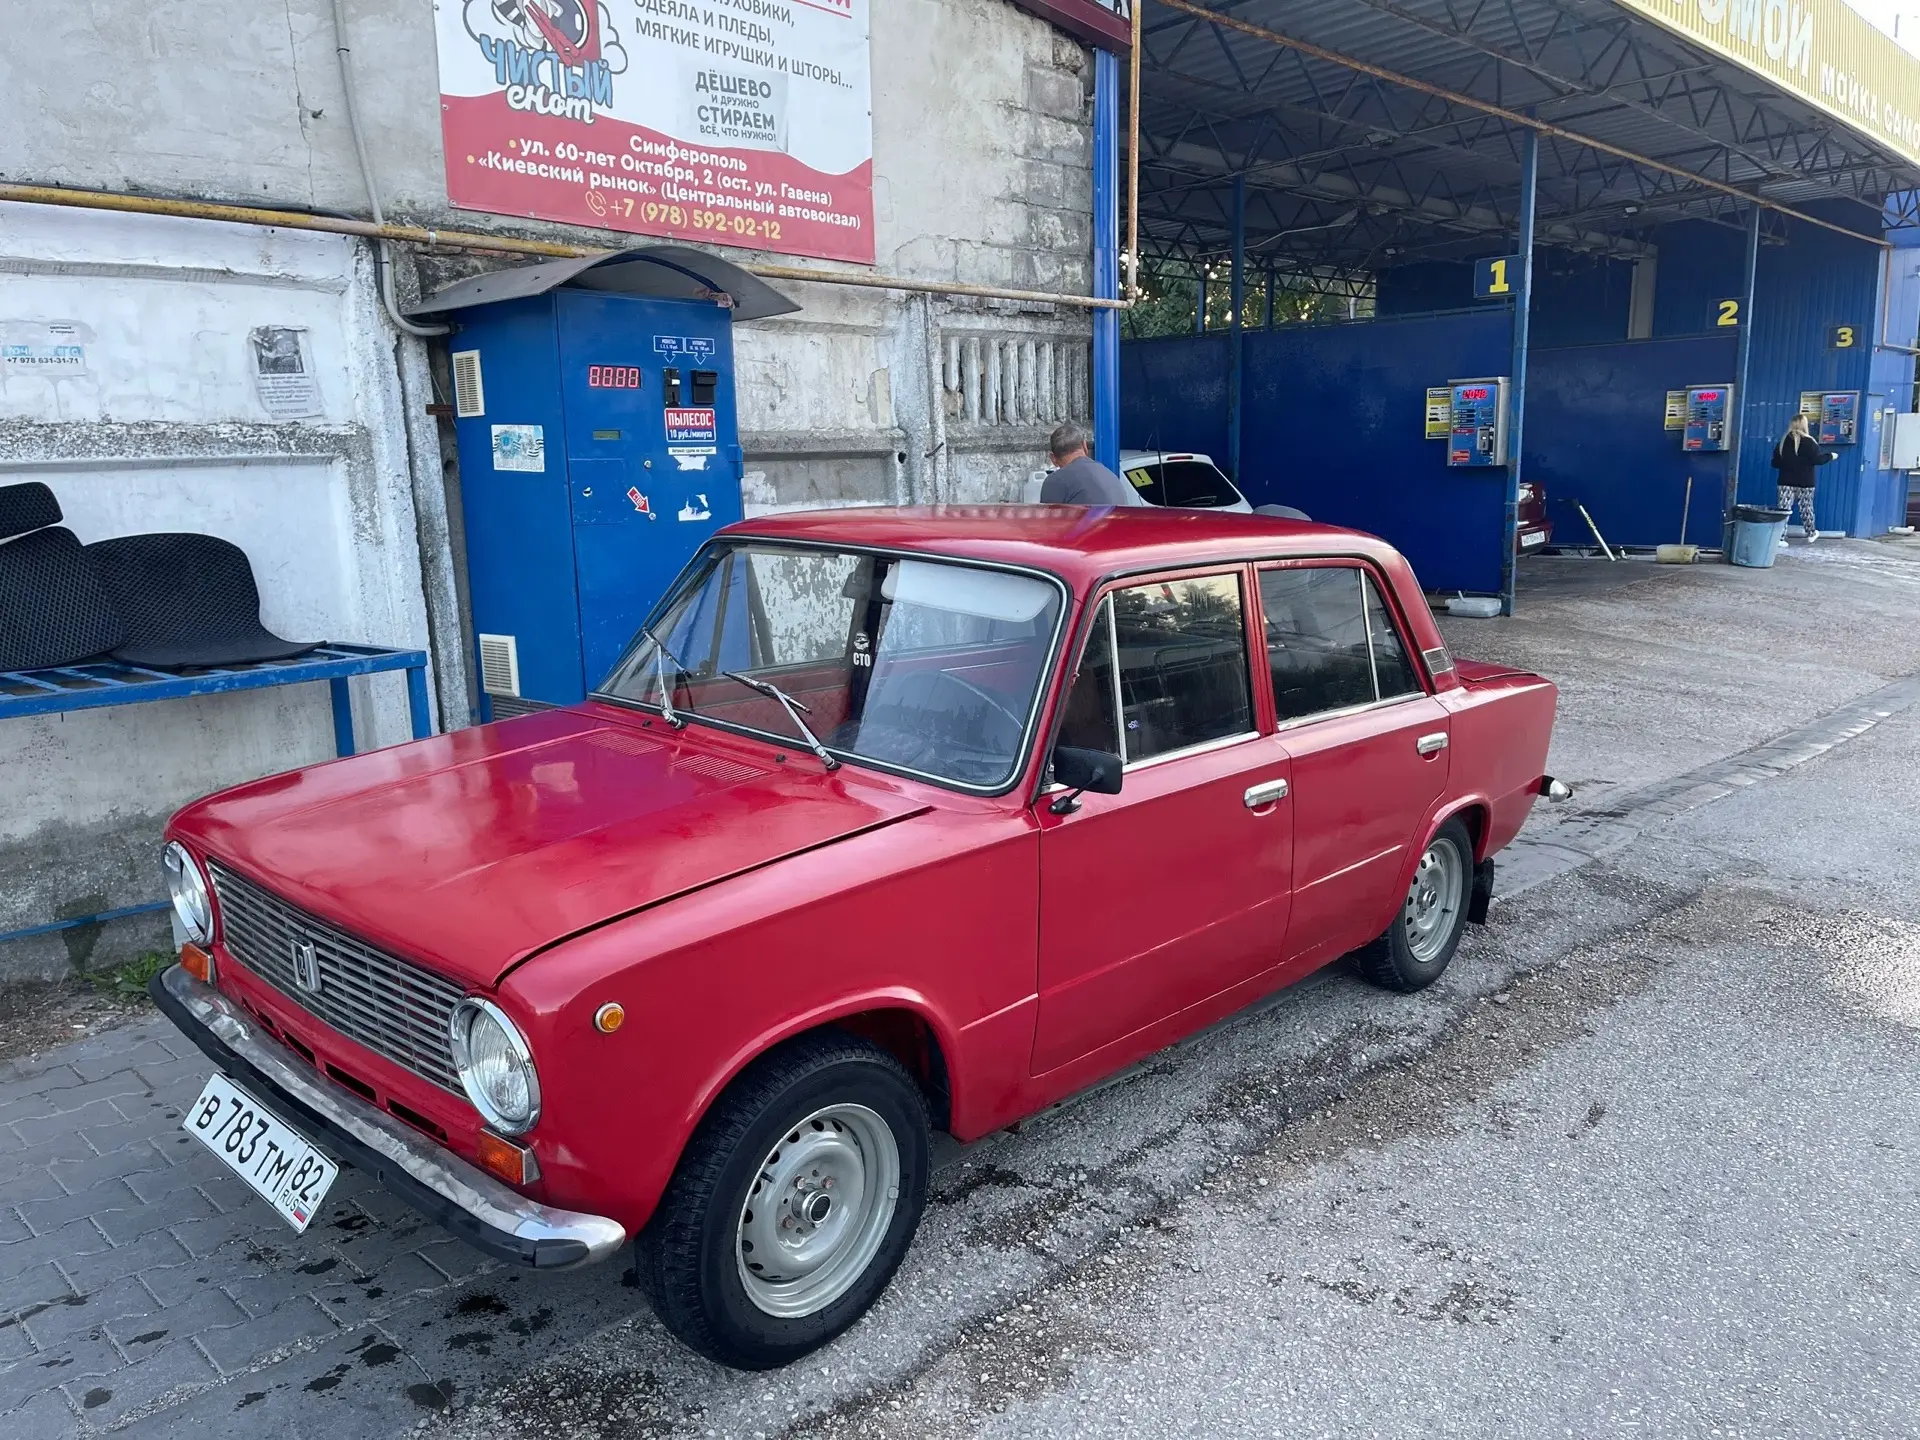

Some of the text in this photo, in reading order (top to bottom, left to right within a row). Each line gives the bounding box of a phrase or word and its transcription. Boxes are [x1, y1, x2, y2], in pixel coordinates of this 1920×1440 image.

[703, 9, 714, 27] И
[718, 14, 775, 46] ПЛЕДЫ,
[714, 0, 795, 27] ХОВИКИ,
[635, 17, 853, 88] МЯГКИЕ ИГРУШКИ И ШТОРЫ...
[479, 33, 613, 109] ЧИСТЫЙ
[695, 69, 772, 99] ДЁШЕВО
[711, 94, 760, 109] И ДРУЖНО
[1821, 62, 1878, 124] МОЙКА
[697, 105, 775, 131] СТИРАЕМ
[721, 127, 739, 137] ЧТО
[741, 129, 777, 142] НУЖНО!
[630, 135, 748, 171] Симферополь
[519, 138, 833, 207] ул. 60-лет Октября, 2 (ост. ул. Гавена)
[478, 151, 861, 230] «Киевский рынок» (Центральный автовокзал)
[610, 198, 782, 240] +7 (978) 592-02-12
[1489, 259, 1509, 293] 1
[1717, 300, 1739, 326] 2
[1835, 327, 1854, 348] 3
[667, 412, 712, 426] ПЫЛЕСОС
[853, 652, 871, 667] СТО
[291, 1155, 325, 1202] 82
[279, 1189, 300, 1212] RUS
